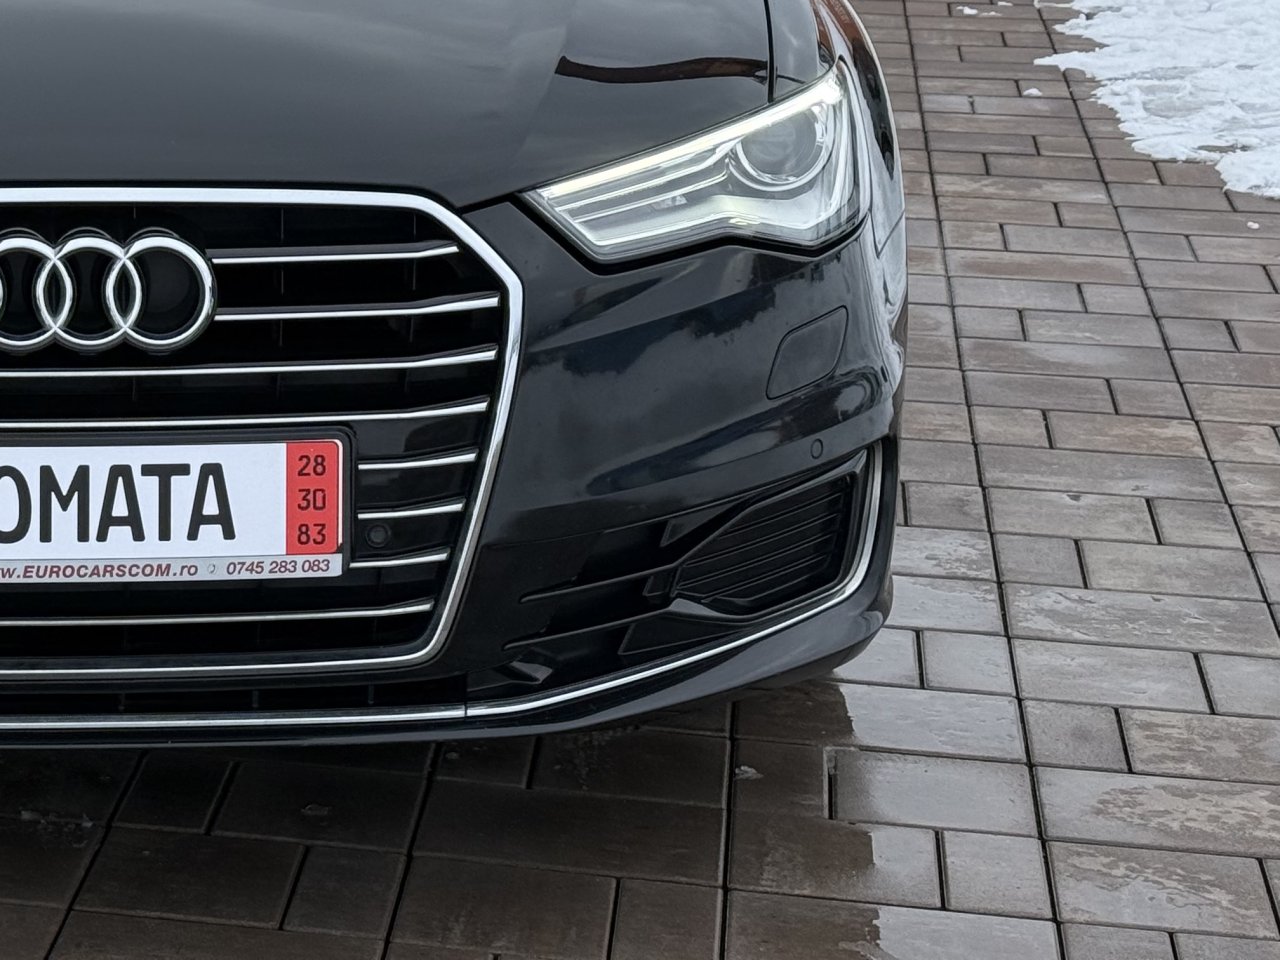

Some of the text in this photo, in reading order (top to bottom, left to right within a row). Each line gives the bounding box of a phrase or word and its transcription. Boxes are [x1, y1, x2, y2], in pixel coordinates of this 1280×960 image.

[297, 454, 326, 477] 28
[297, 487, 326, 511] 30
[297, 523, 326, 546] 83
[226, 561, 264, 576] 0745
[268, 560, 298, 575] 283
[301, 559, 331, 573] 083
